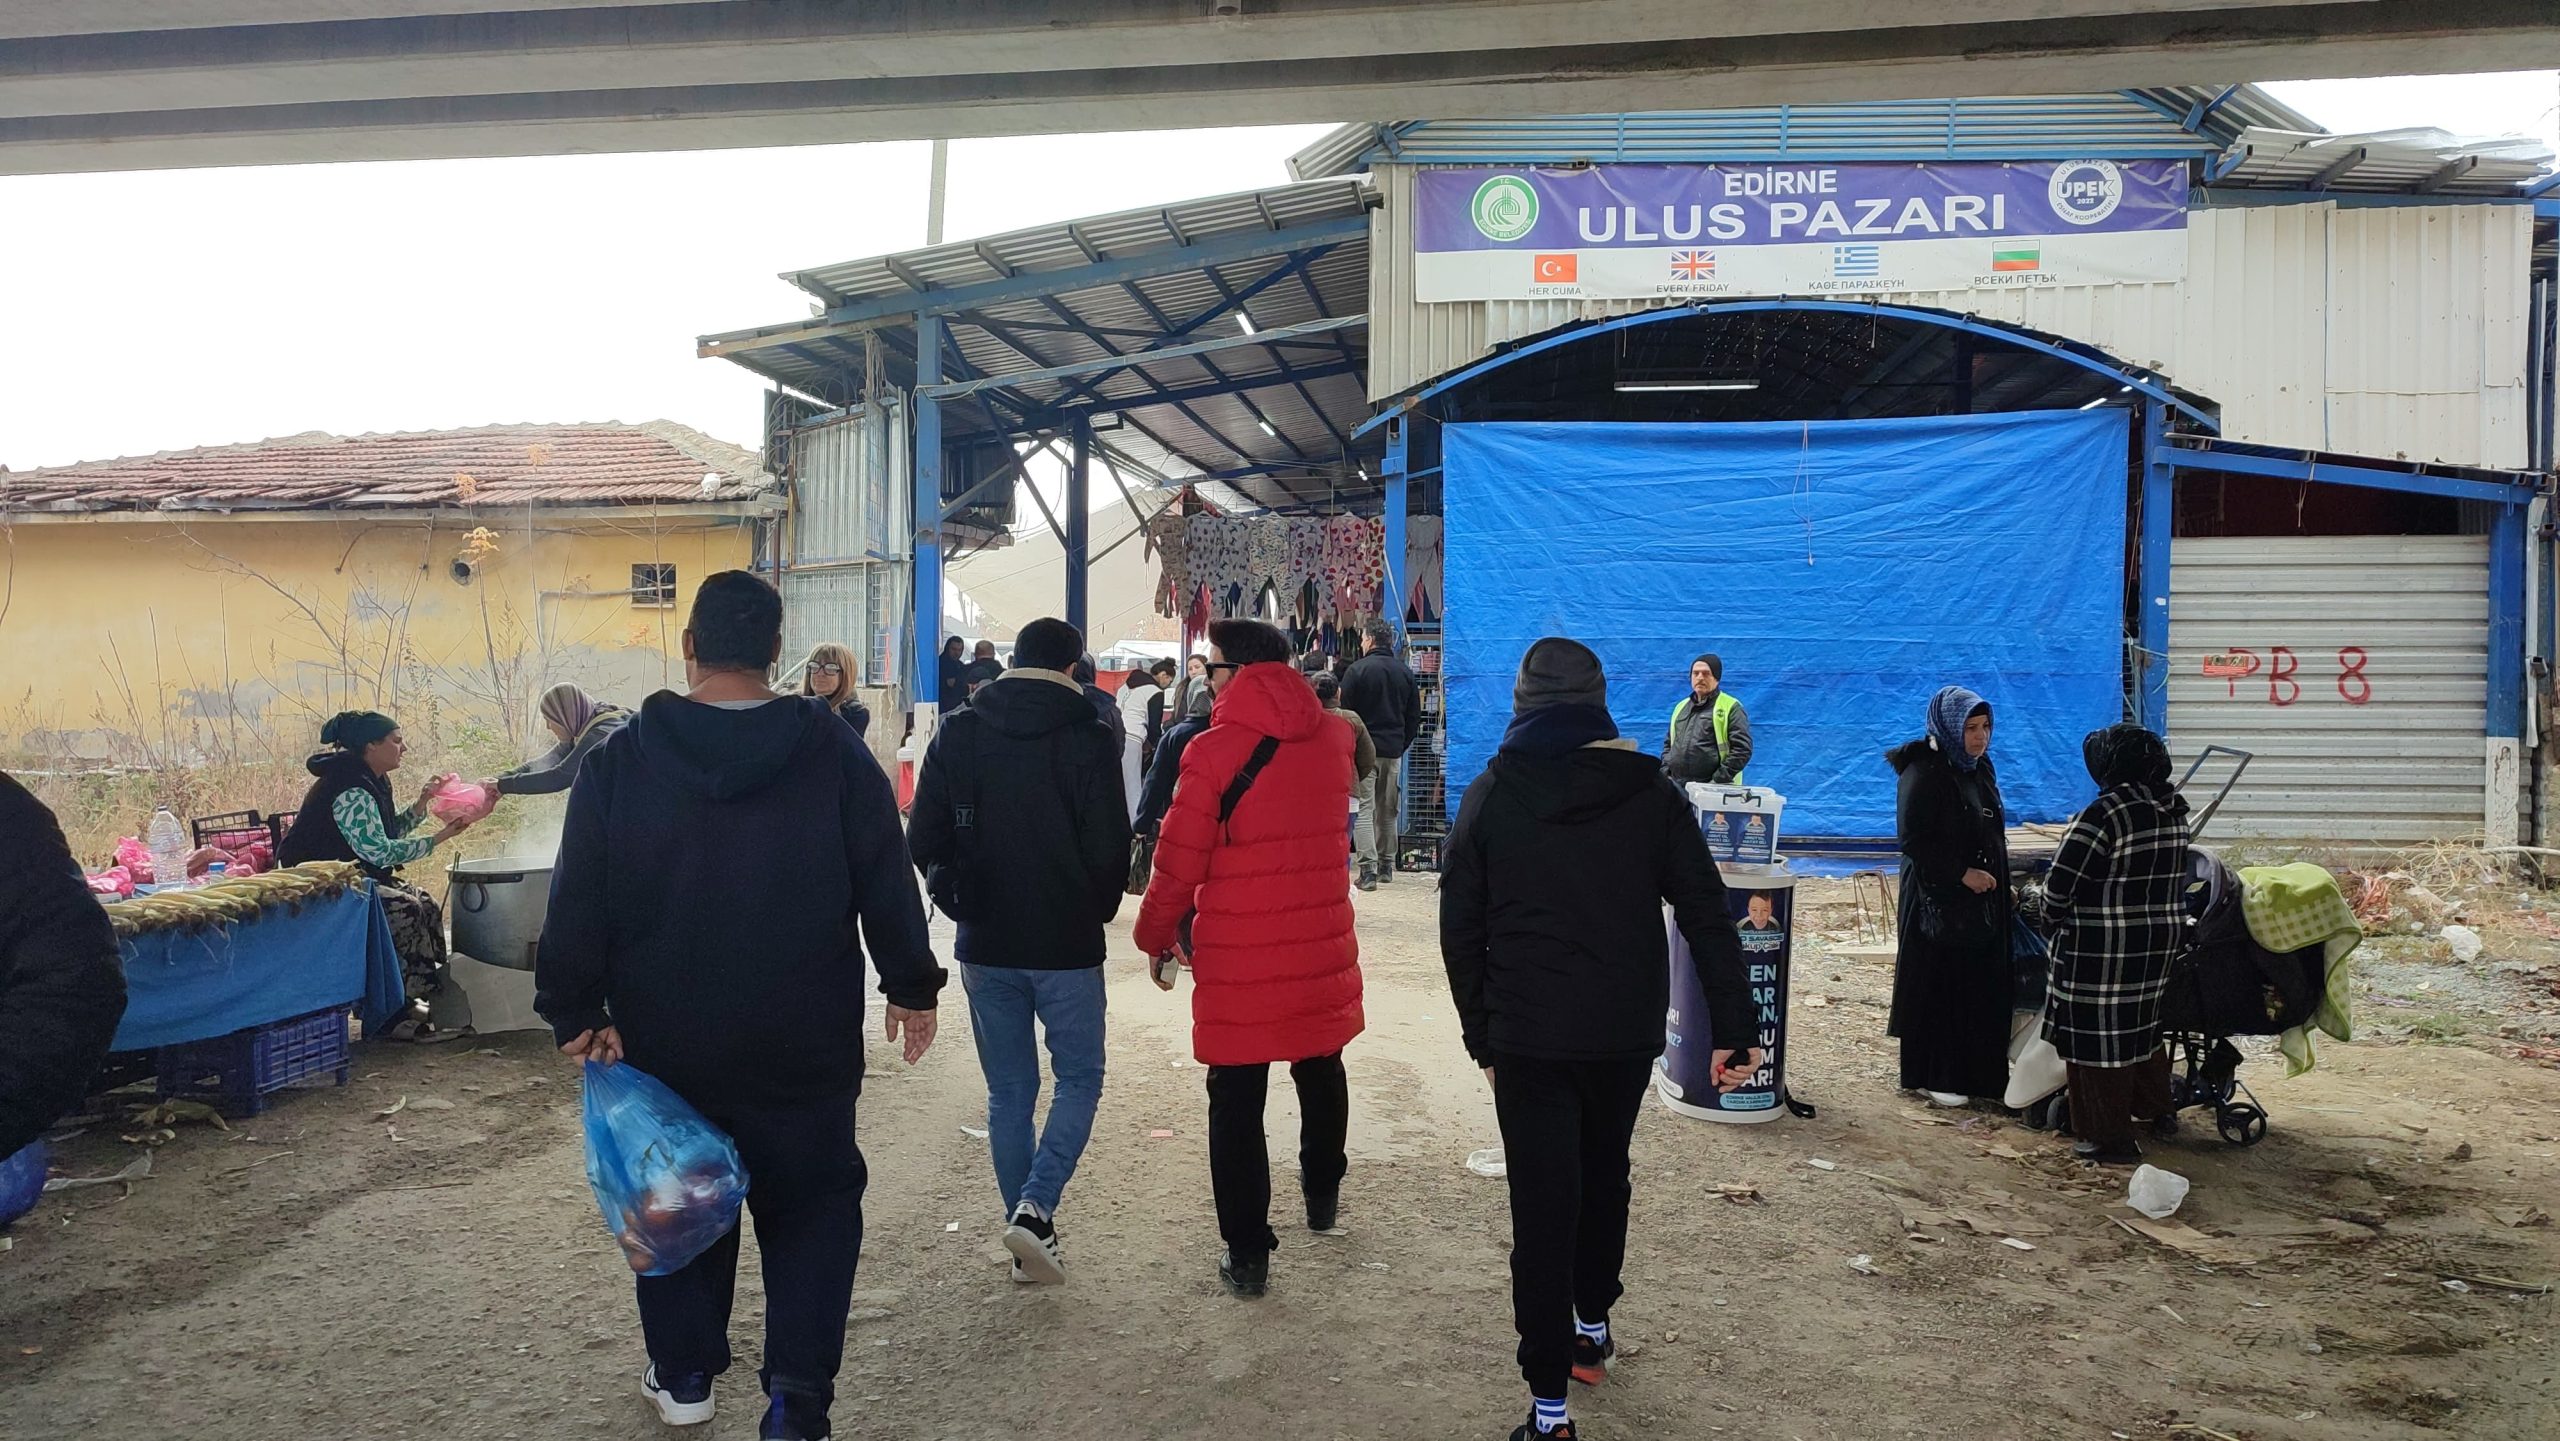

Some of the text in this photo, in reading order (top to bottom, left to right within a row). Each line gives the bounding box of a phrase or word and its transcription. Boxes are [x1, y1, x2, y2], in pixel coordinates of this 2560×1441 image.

[1724, 167, 1838, 197] EDİRNE
[2057, 180, 2116, 198] UPEK
[1578, 194, 2006, 243] ULUS PAZARI
[1808, 281, 1838, 290] ΚΑΘΕ
[1974, 273, 2057, 285] ВСЕКИ ПЕТЪК
[1528, 287, 1582, 296] HER CUMA
[1656, 283, 1729, 293] EVERY FRIDAY
[2337, 646, 2372, 705] 8
